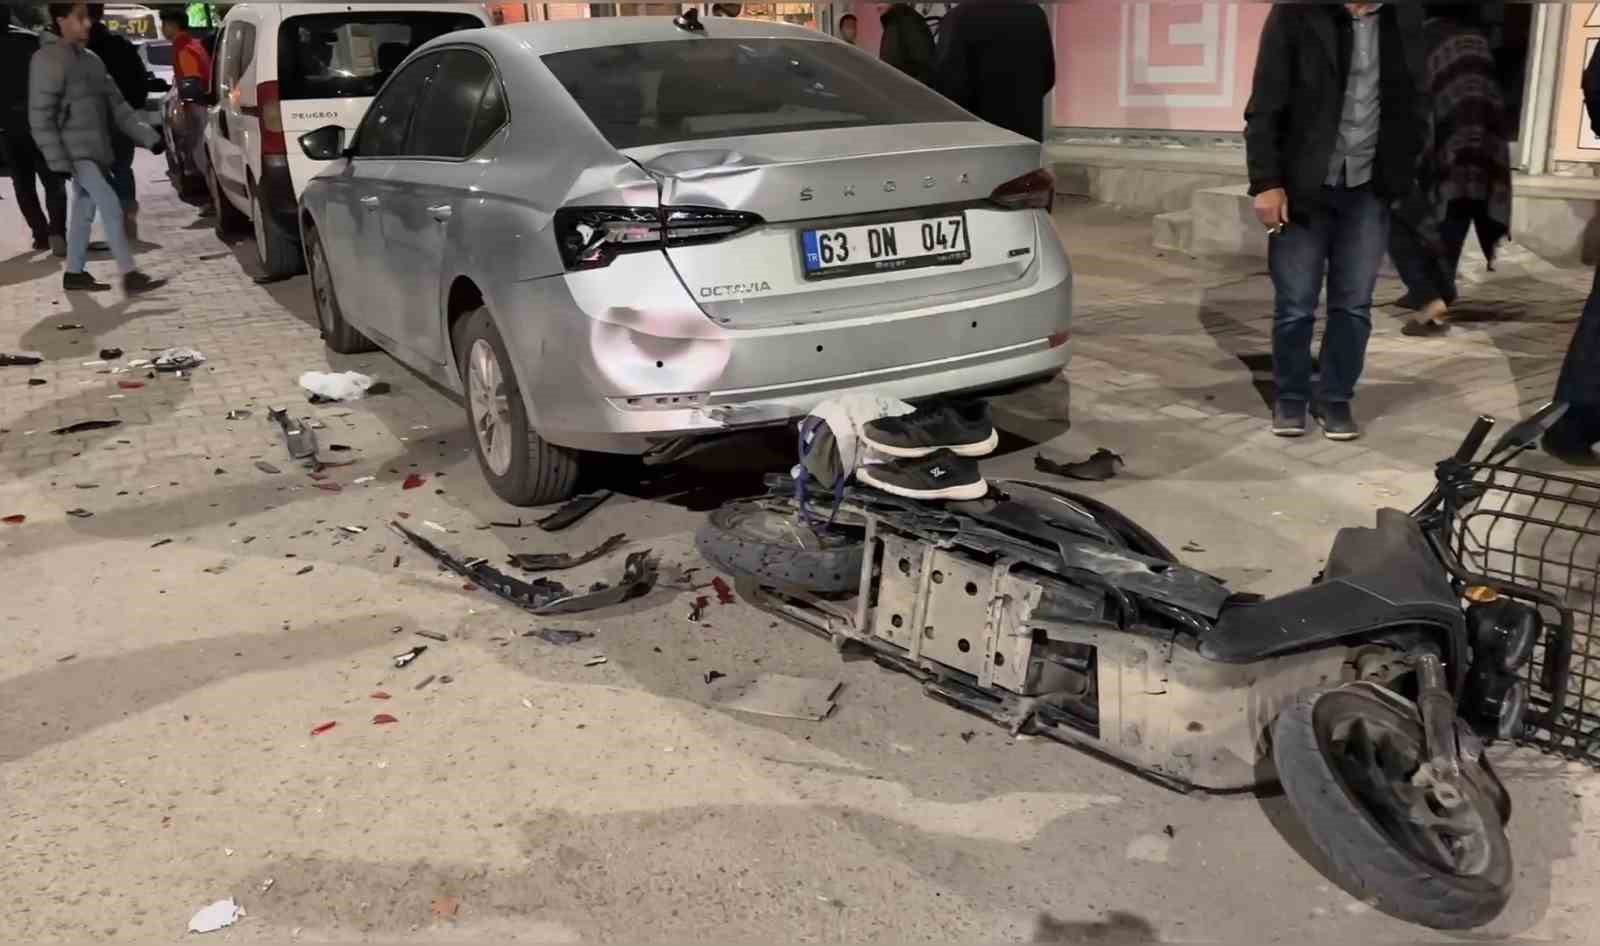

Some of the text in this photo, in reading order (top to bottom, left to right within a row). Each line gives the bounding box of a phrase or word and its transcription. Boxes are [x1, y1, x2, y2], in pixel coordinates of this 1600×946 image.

[819, 220, 961, 263] 63 DN 047
[807, 253, 818, 262] TR
[700, 281, 771, 297] OCTAVIA
